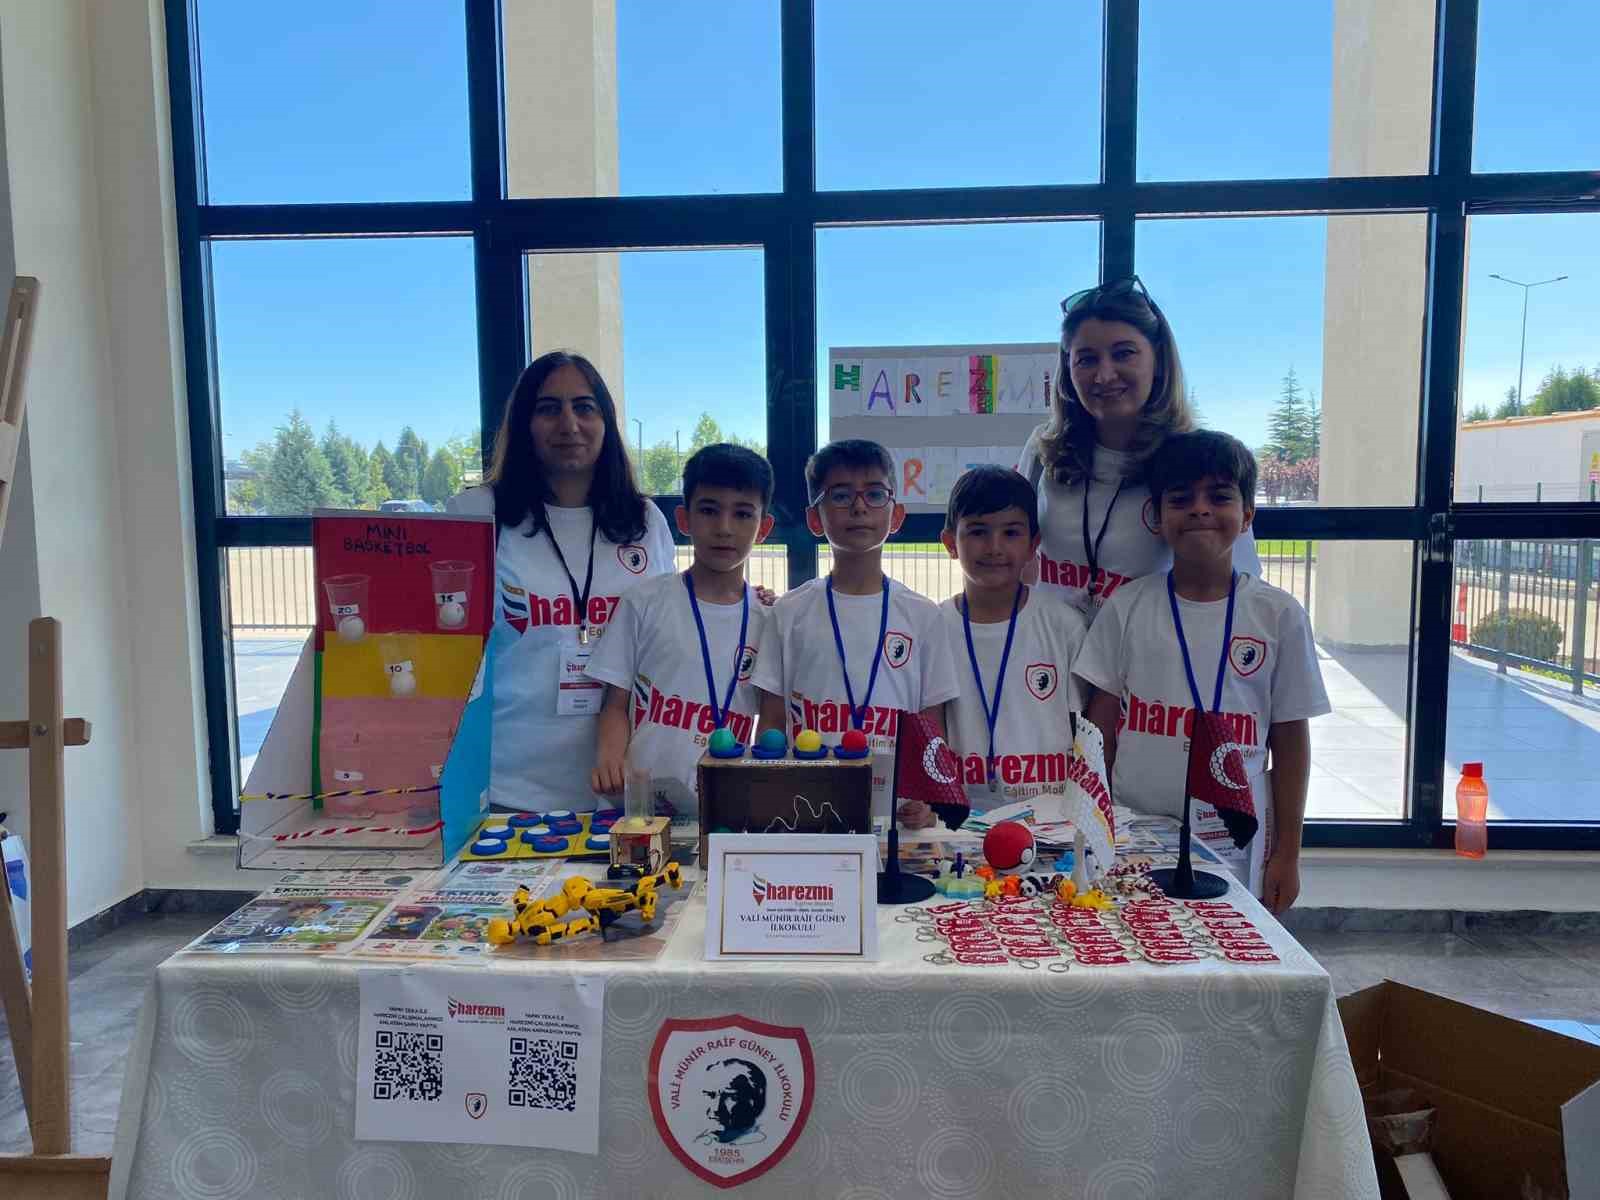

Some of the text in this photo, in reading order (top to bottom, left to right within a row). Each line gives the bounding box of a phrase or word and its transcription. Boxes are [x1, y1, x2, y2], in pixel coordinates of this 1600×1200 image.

[337, 606, 353, 615] 20
[389, 664, 403, 674] 10
[1042, 784, 1066, 795] Mod
[740, 911, 847, 923] VALİ MÜNİR RAİF GÜNEY
[770, 922, 816, 932] İLKOKULU
[670, 1035, 793, 1121] VALİ MÜNİR RAİF GÜNEY İLKOKULU
[714, 1148, 740, 1157] 1985
